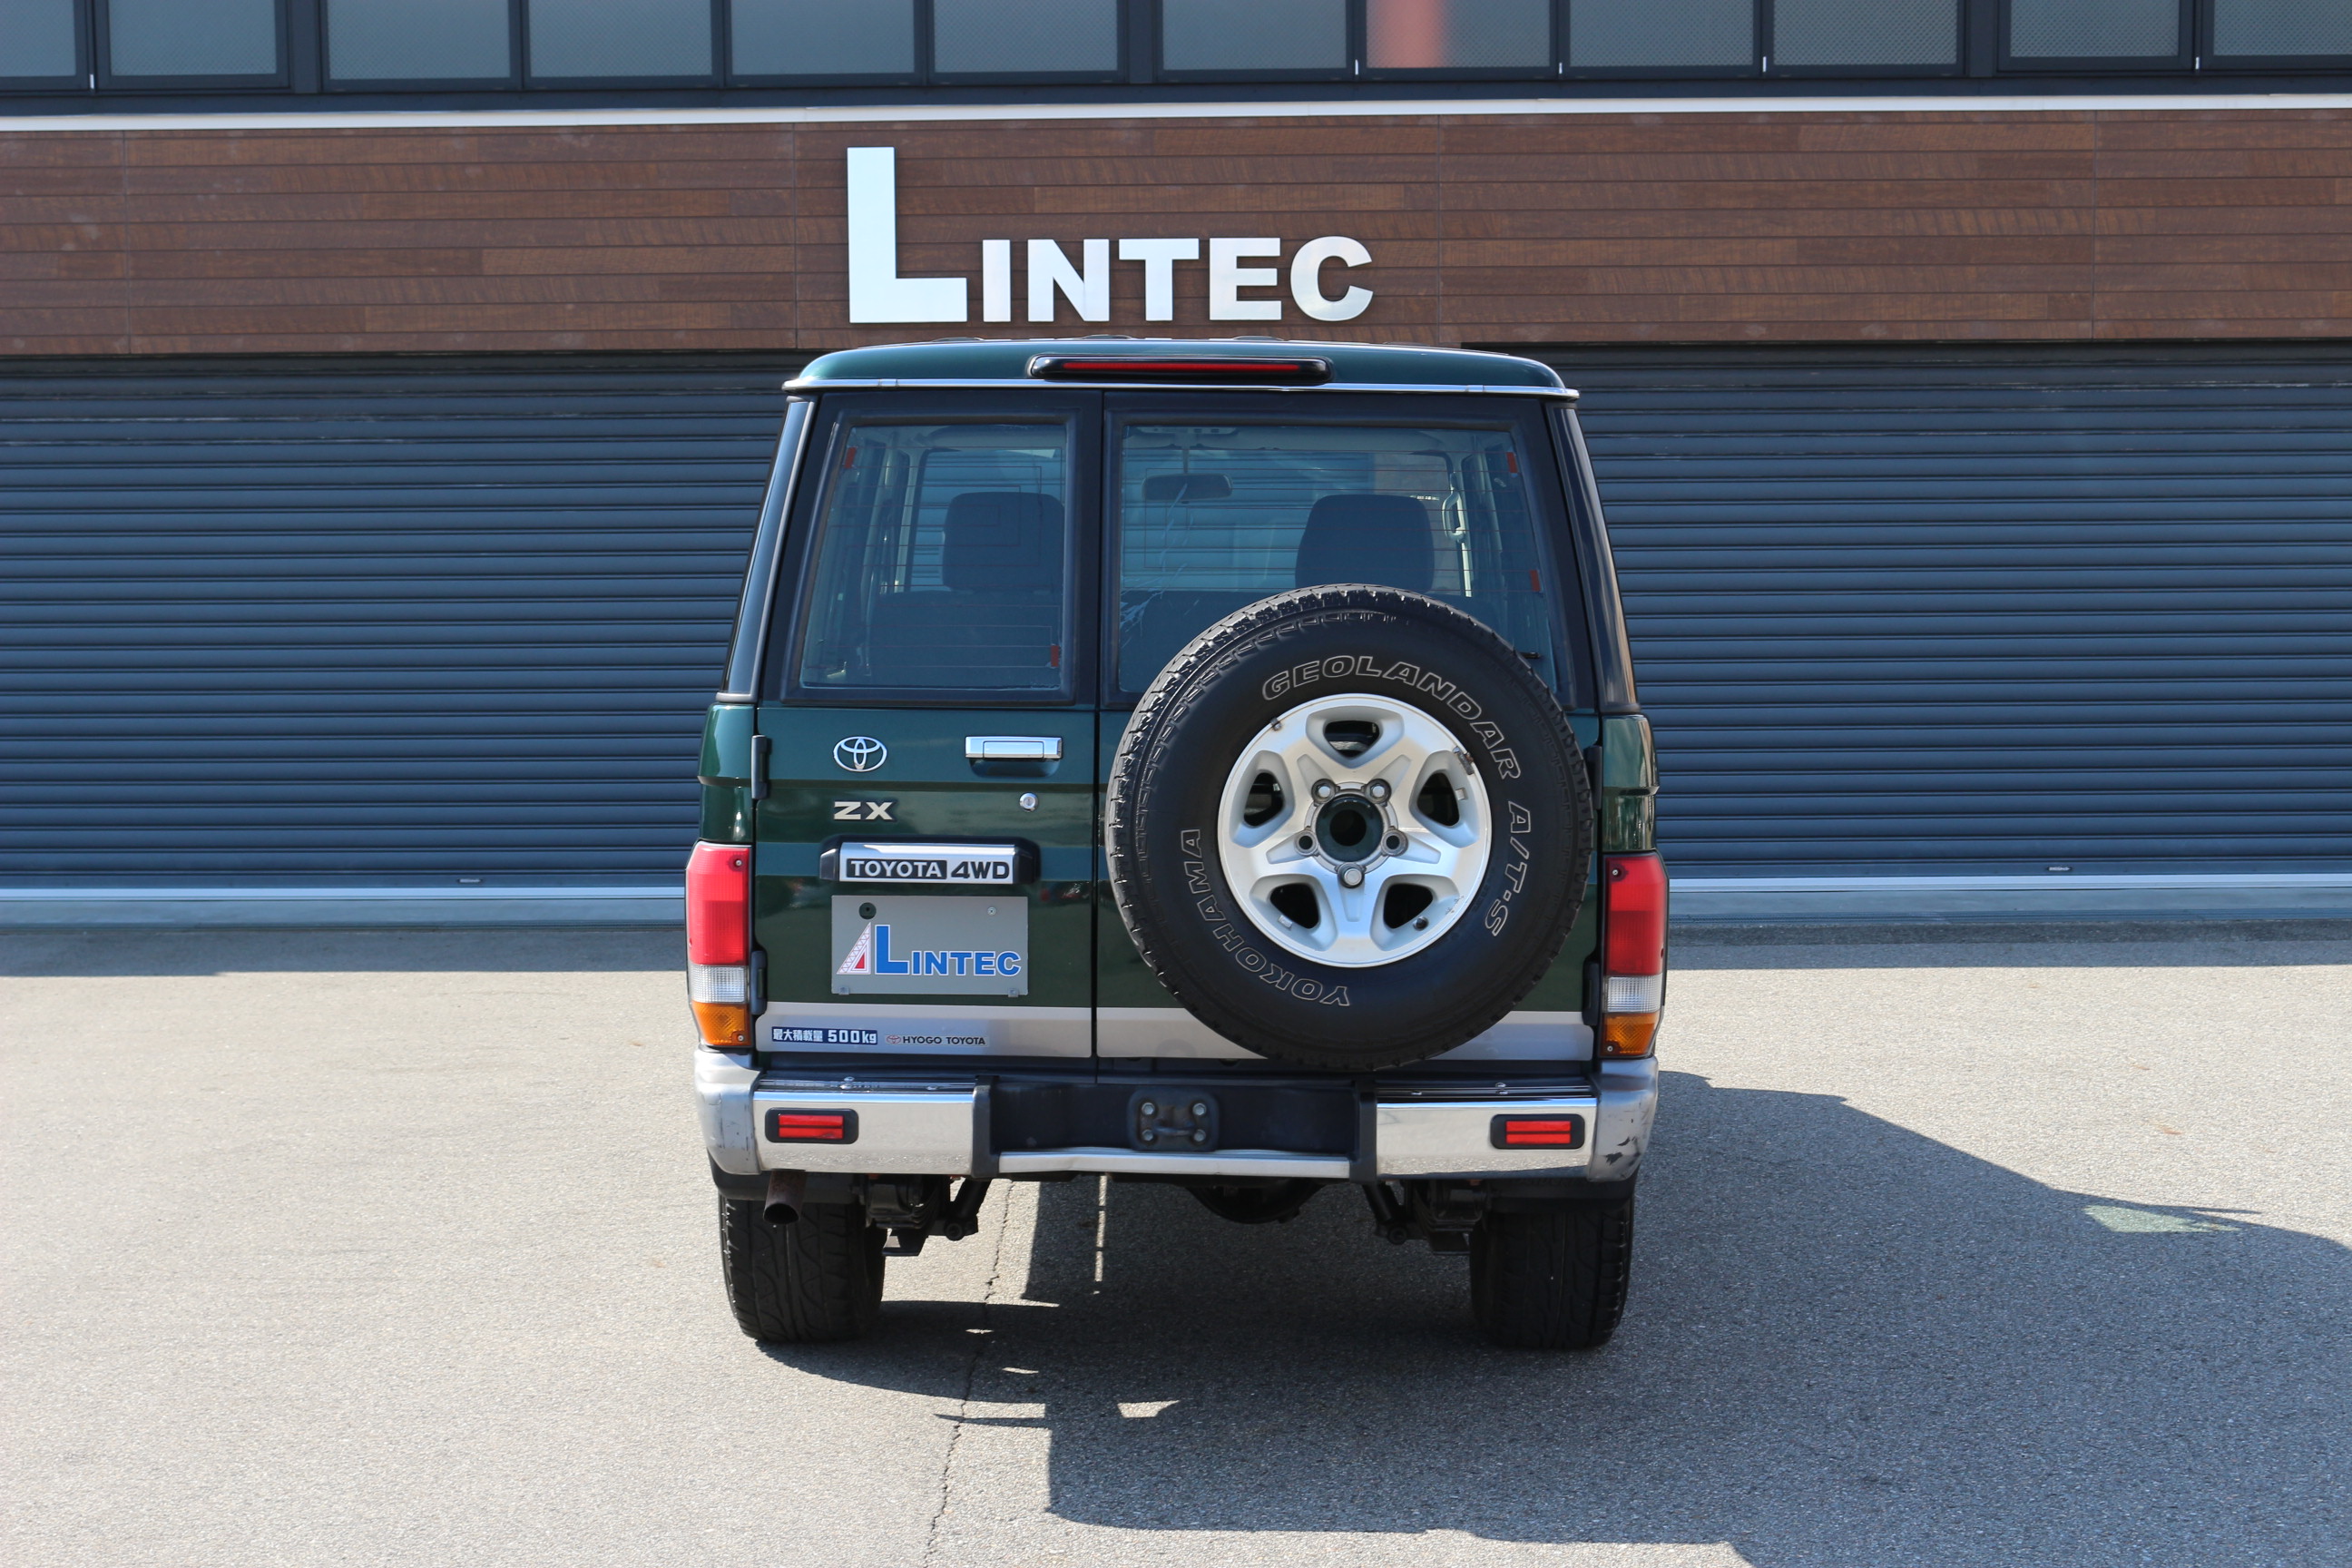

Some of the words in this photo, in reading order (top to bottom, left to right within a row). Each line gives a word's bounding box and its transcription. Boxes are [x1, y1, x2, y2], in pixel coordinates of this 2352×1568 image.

[847, 146, 1373, 324] LINTEC
[1261, 654, 1522, 780] GEOLANDAR
[833, 800, 895, 821] ZX
[850, 859, 942, 879] TOYOTA
[951, 860, 1010, 880] 4WD
[1180, 828, 1351, 1007] YOKOHAMA
[873, 924, 1022, 976] LINTEC
[772, 1027, 824, 1043] 最大積載量
[827, 1029, 877, 1044] 500kg
[902, 1035, 943, 1044] HYOGO
[946, 1036, 986, 1045] TOYOTA
